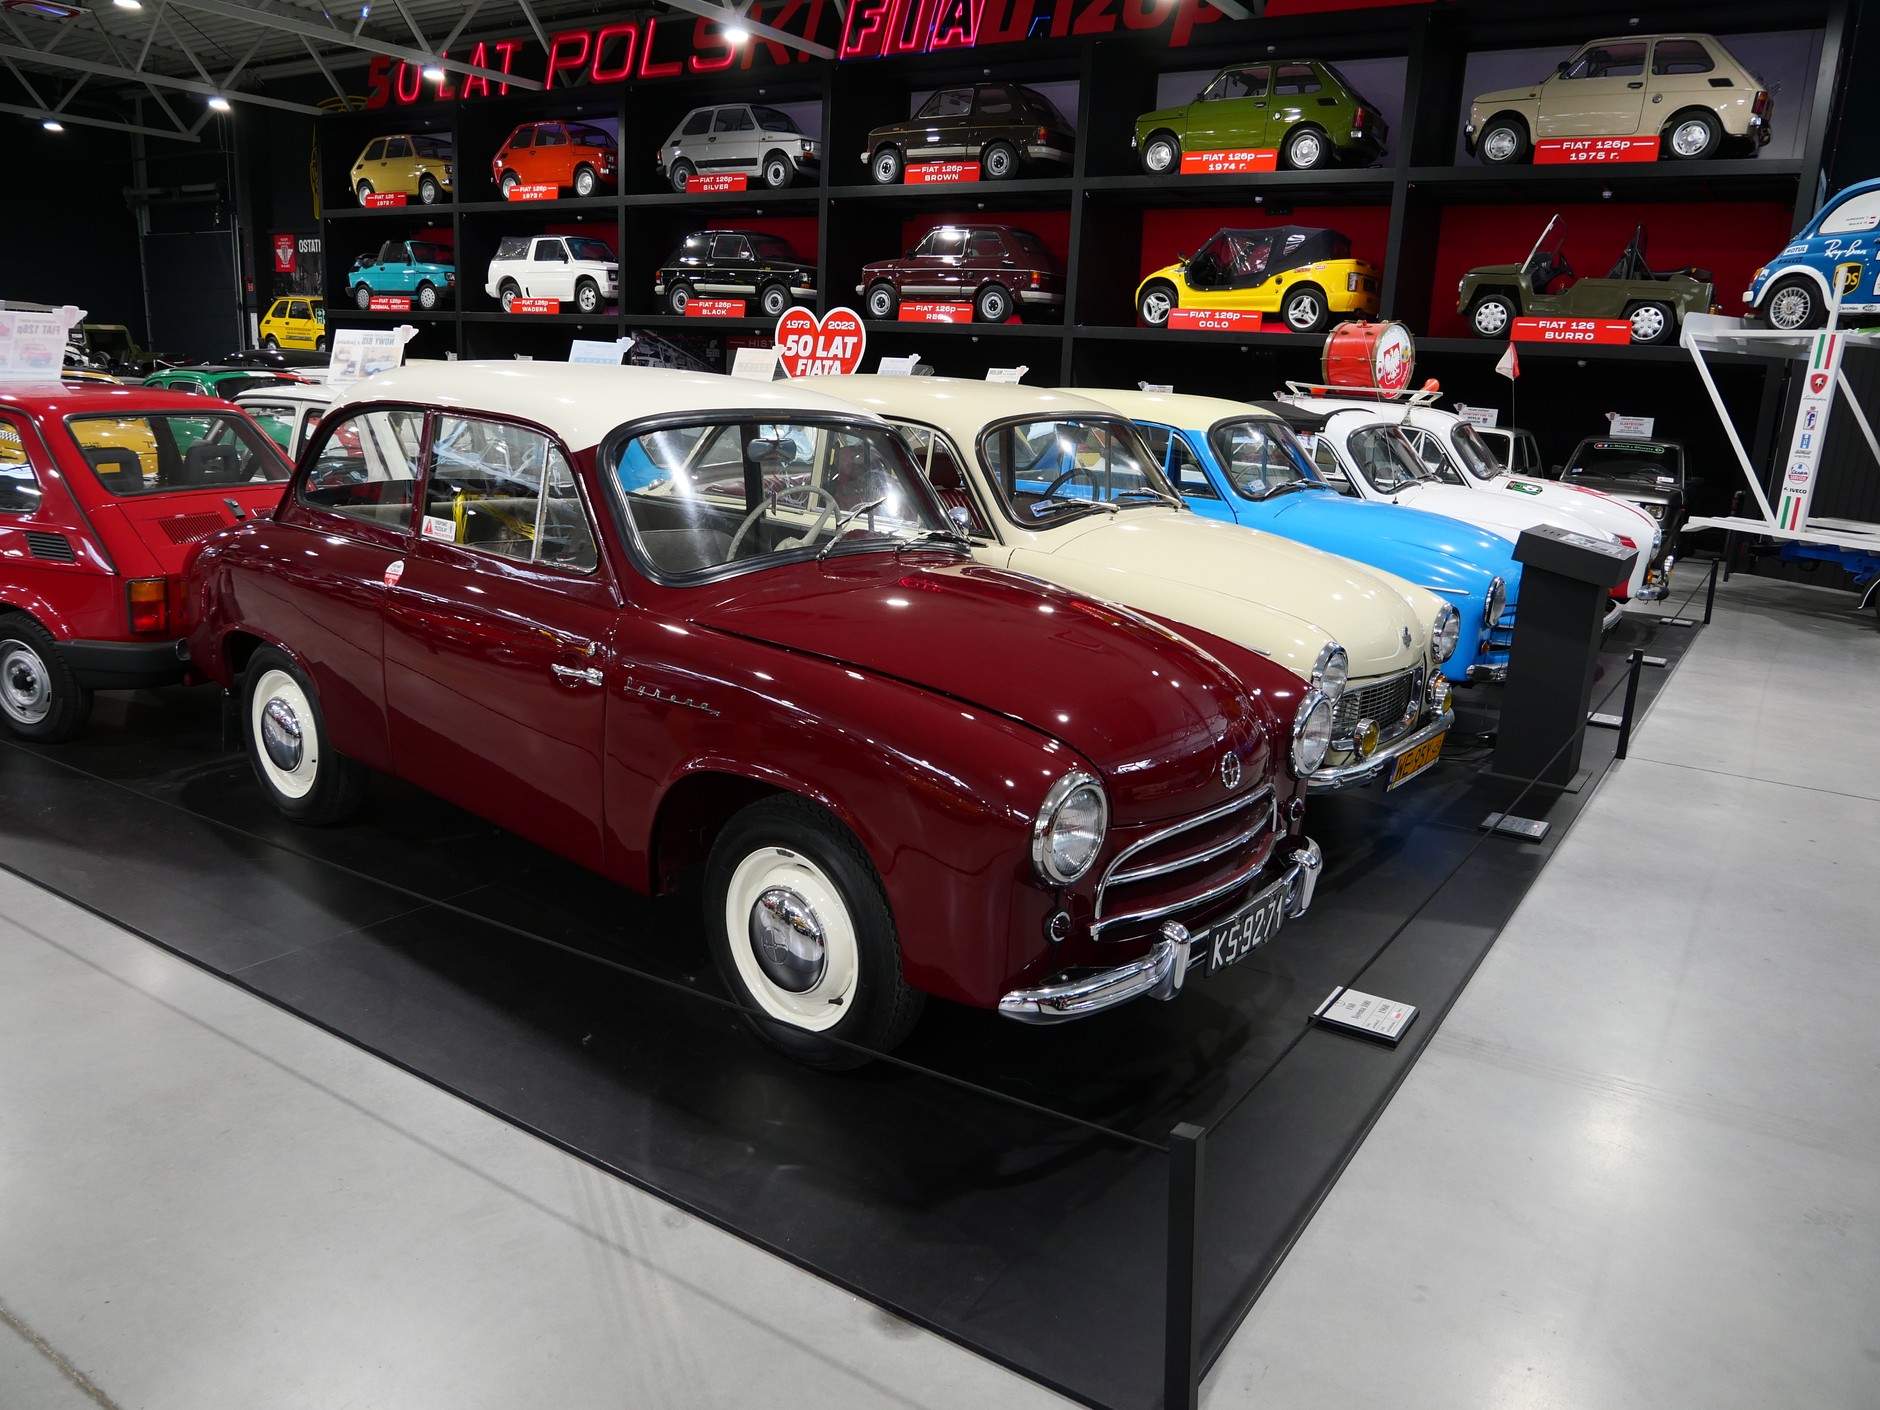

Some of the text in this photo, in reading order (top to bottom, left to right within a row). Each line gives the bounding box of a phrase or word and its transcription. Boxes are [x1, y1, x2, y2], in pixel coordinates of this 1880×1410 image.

[1562, 140, 1631, 150] FIAT 126p
[1202, 152, 1255, 161] FIAT 126p
[1569, 151, 1606, 161] 1975
[941, 165, 963, 173] 126p
[1208, 162, 1236, 171] 1974
[924, 173, 959, 181] BROWN
[703, 183, 729, 191] SILVER
[1824, 239, 1867, 260] Ray-Ban
[935, 305, 956, 313] 126p
[1189, 311, 1241, 320] FIAT 126p
[786, 320, 855, 330] 1973 2023
[1538, 320, 1595, 330] FIAT 126
[1544, 331, 1595, 341] BURRO
[784, 334, 858, 359] 50 LAT
[796, 358, 842, 376] FIATA
